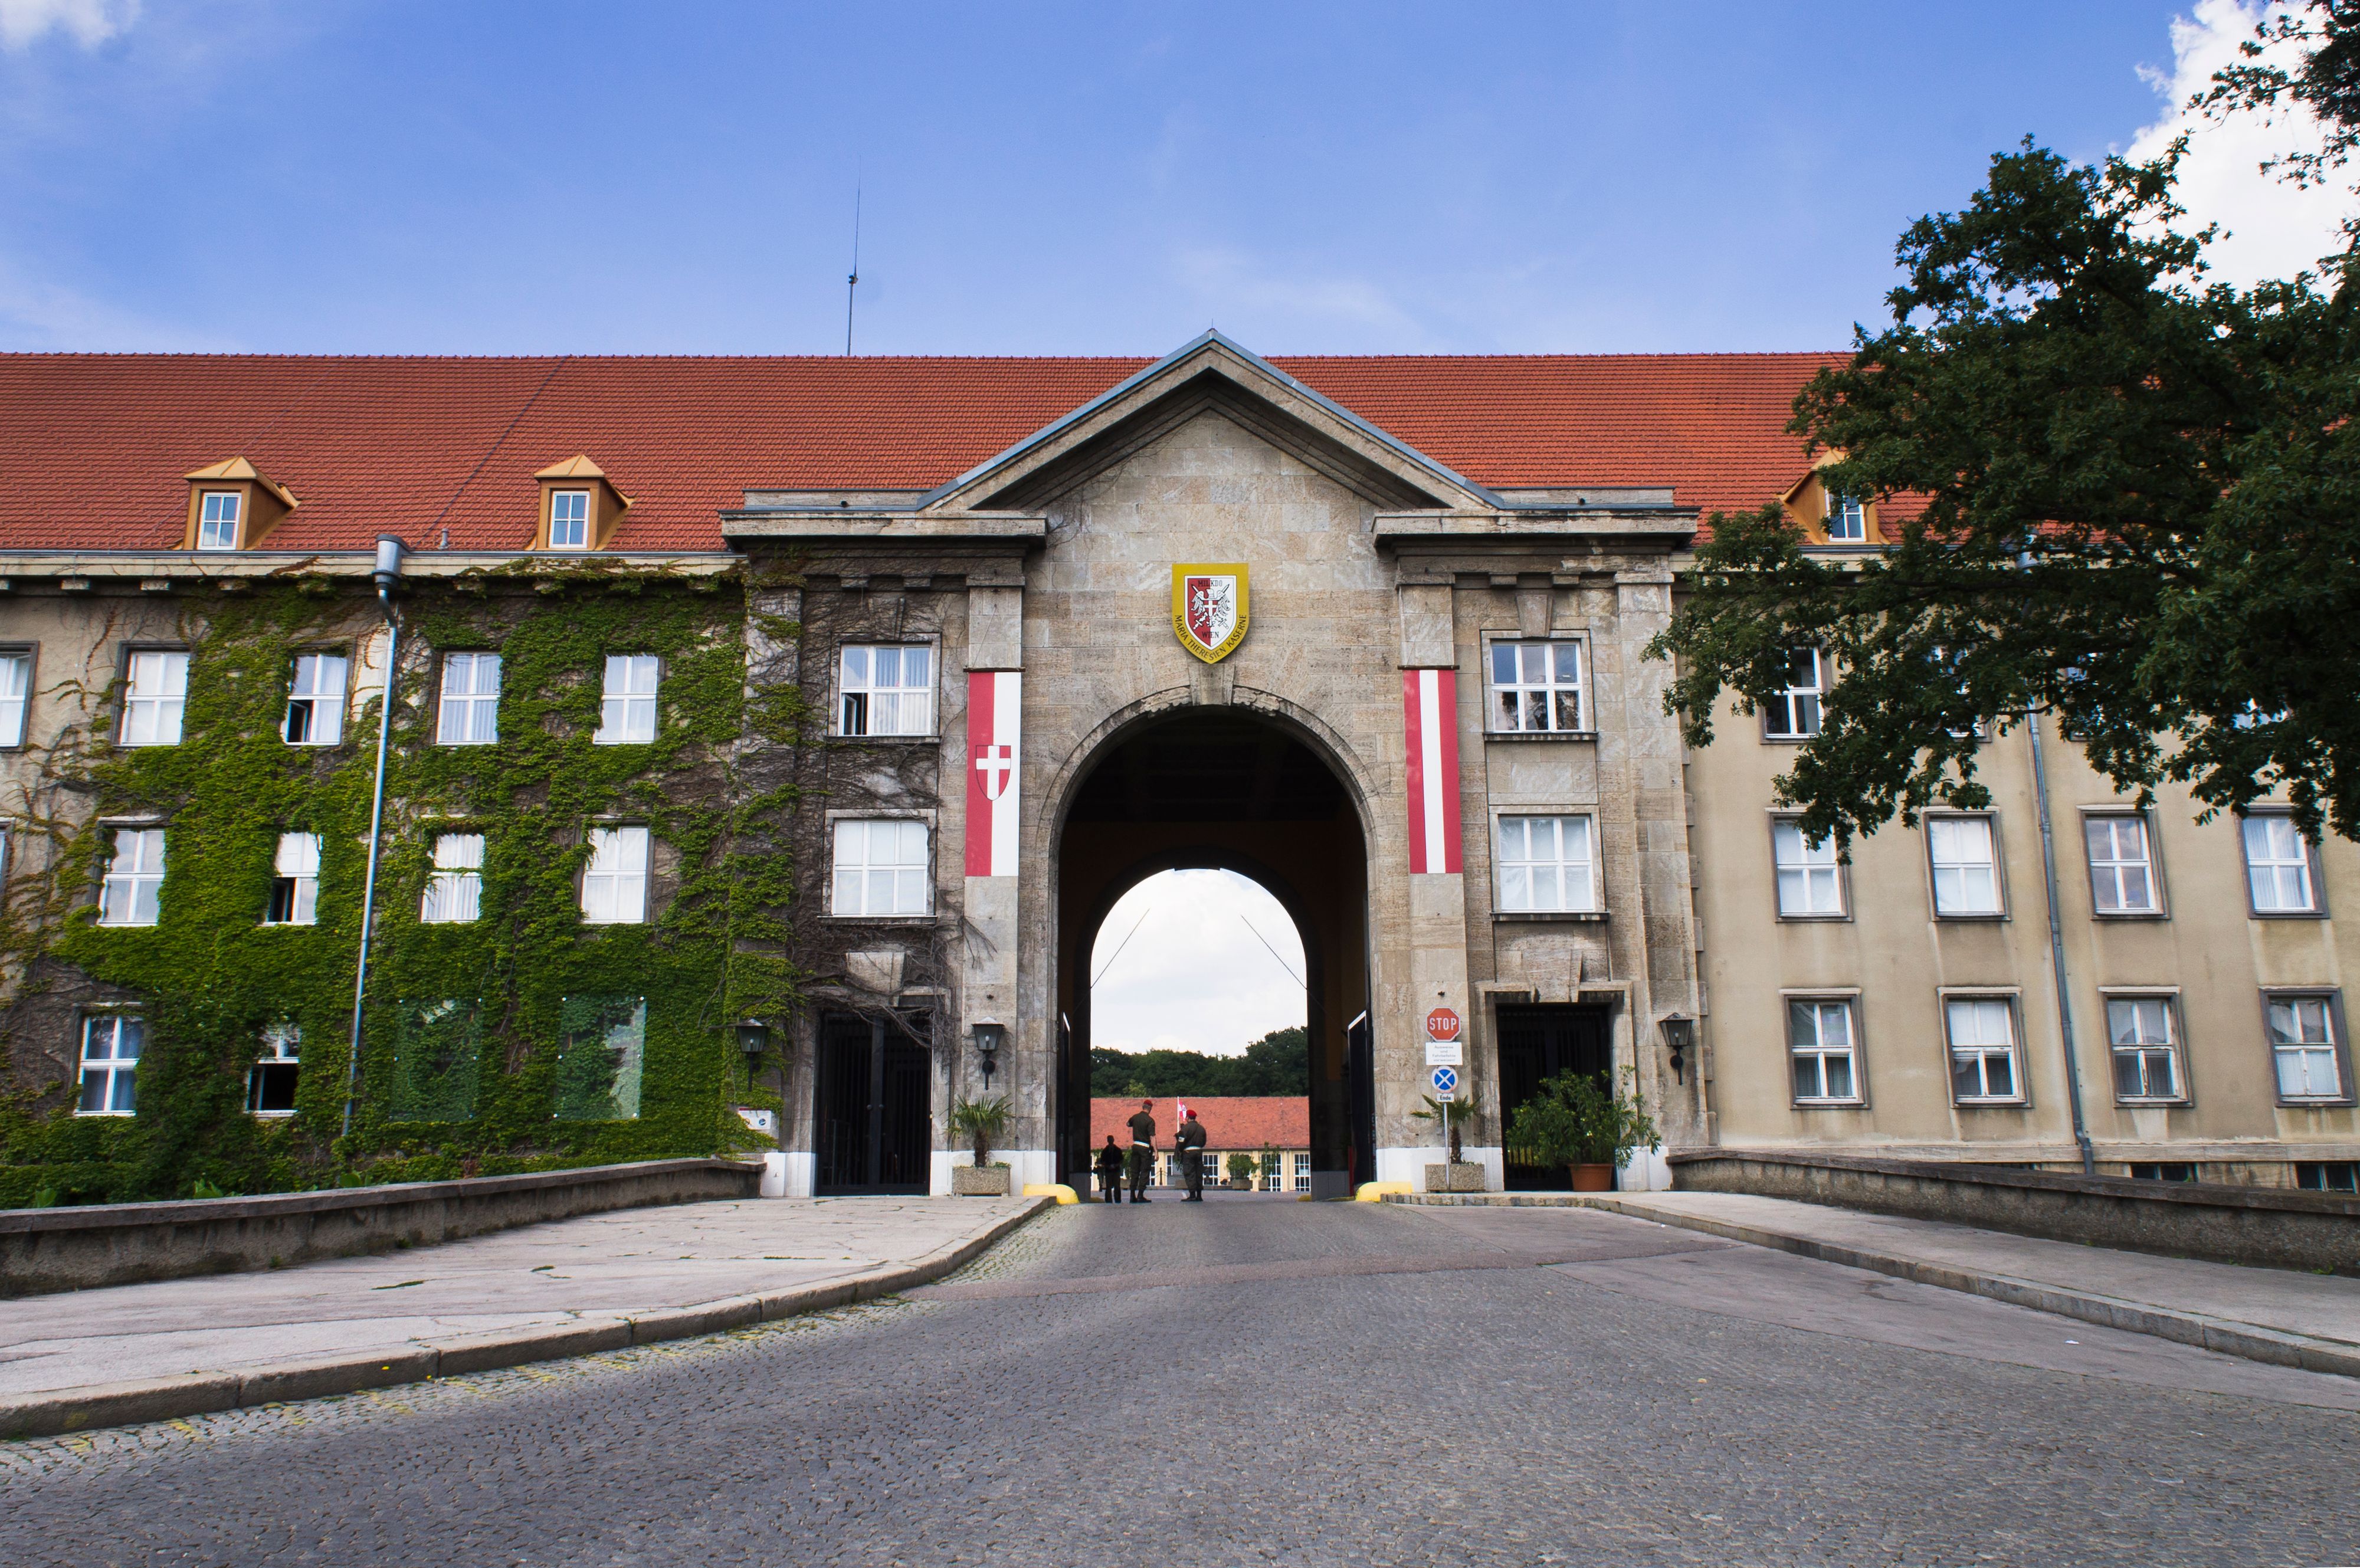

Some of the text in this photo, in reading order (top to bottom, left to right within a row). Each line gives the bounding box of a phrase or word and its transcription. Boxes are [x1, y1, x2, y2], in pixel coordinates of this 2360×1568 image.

[1175, 615, 1247, 661] MARIA THERESIEN KASERNE
[1429, 1018, 1457, 1031] STOP
